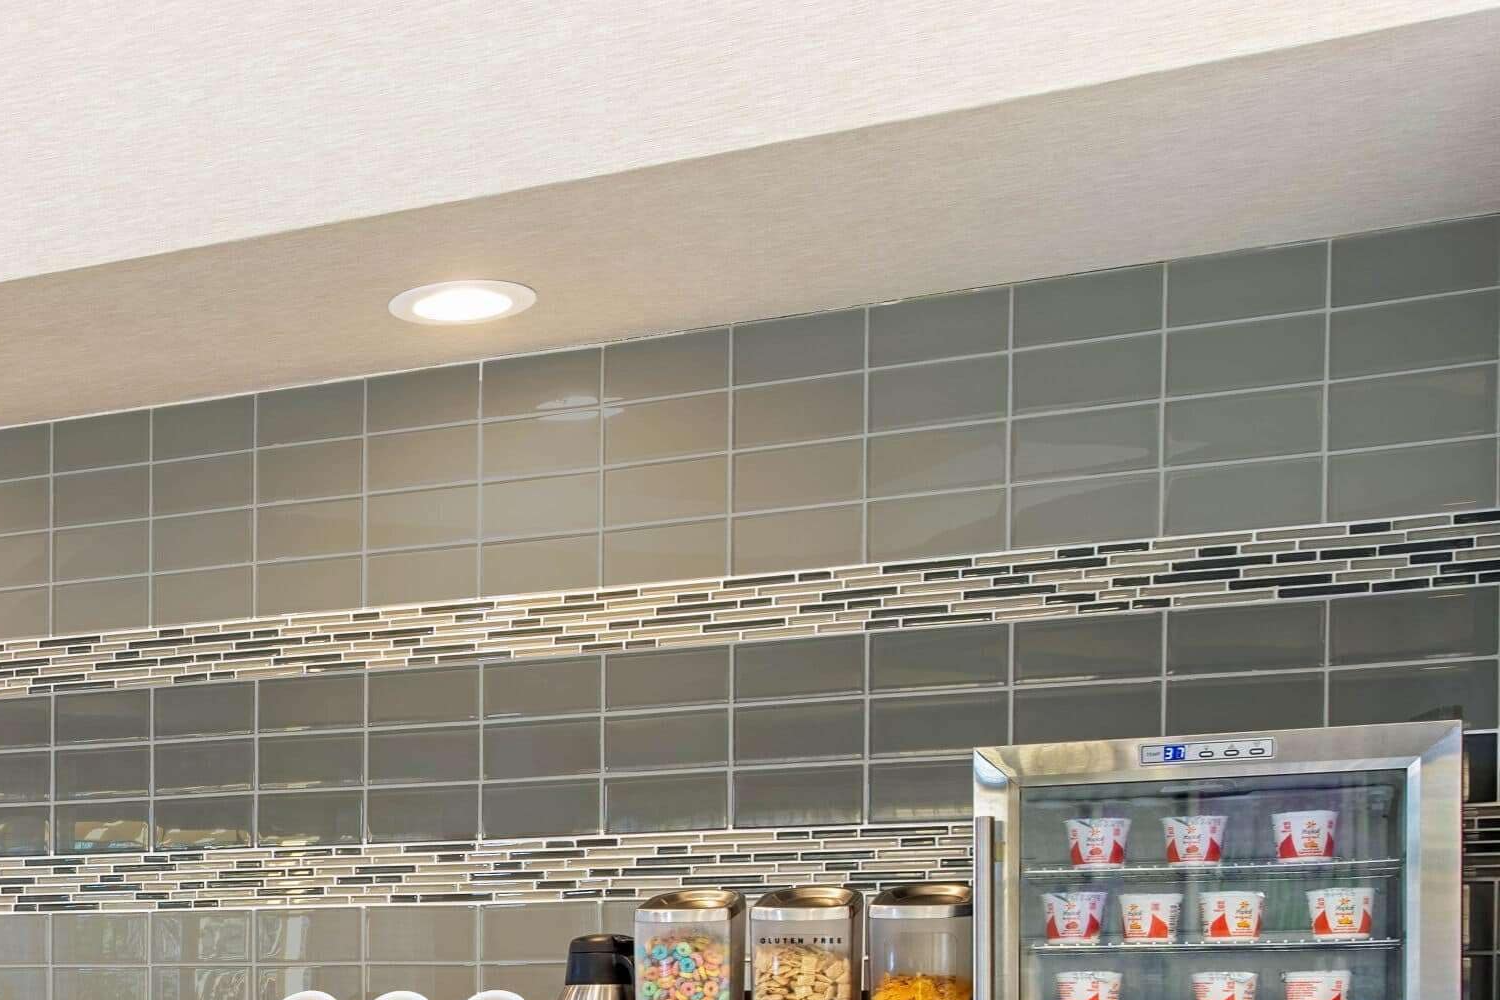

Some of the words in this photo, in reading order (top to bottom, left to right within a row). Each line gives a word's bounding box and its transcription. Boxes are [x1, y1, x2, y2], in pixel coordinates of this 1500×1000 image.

[1164, 747, 1185, 760] 37
[760, 937, 804, 945] GLUTEN
[813, 937, 842, 945] FREE
